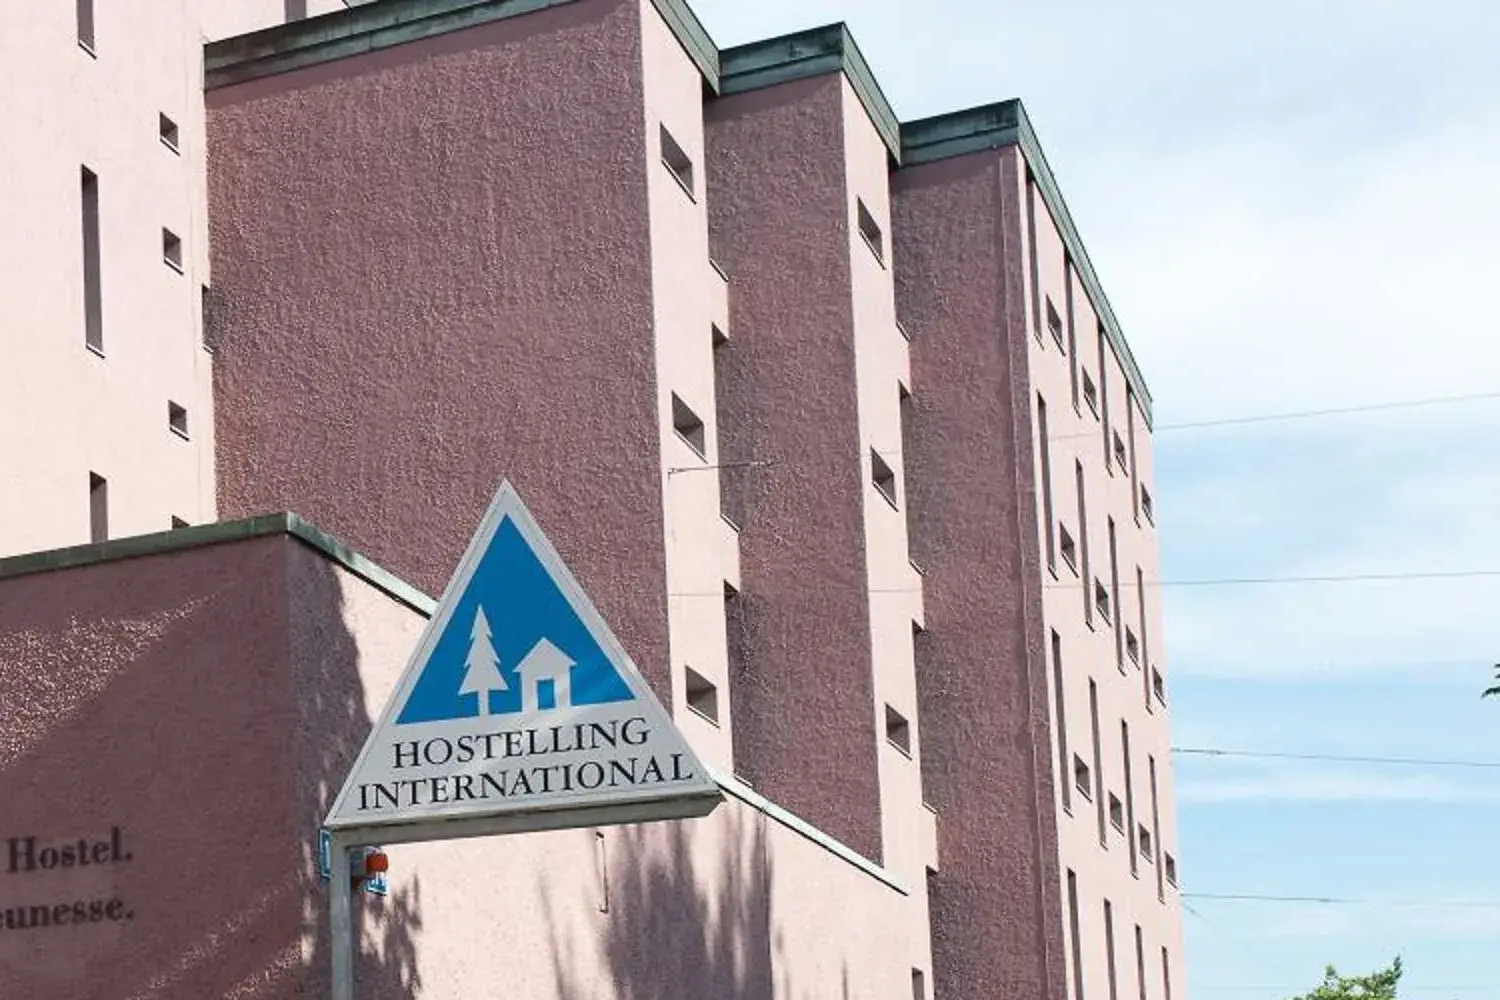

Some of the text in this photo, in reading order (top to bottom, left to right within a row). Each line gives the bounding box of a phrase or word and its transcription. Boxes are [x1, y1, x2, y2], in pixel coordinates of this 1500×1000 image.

[392, 716, 652, 769] HOSTELLING
[357, 753, 693, 810] INTERNATIONAL
[4, 826, 134, 874] Hostel.
